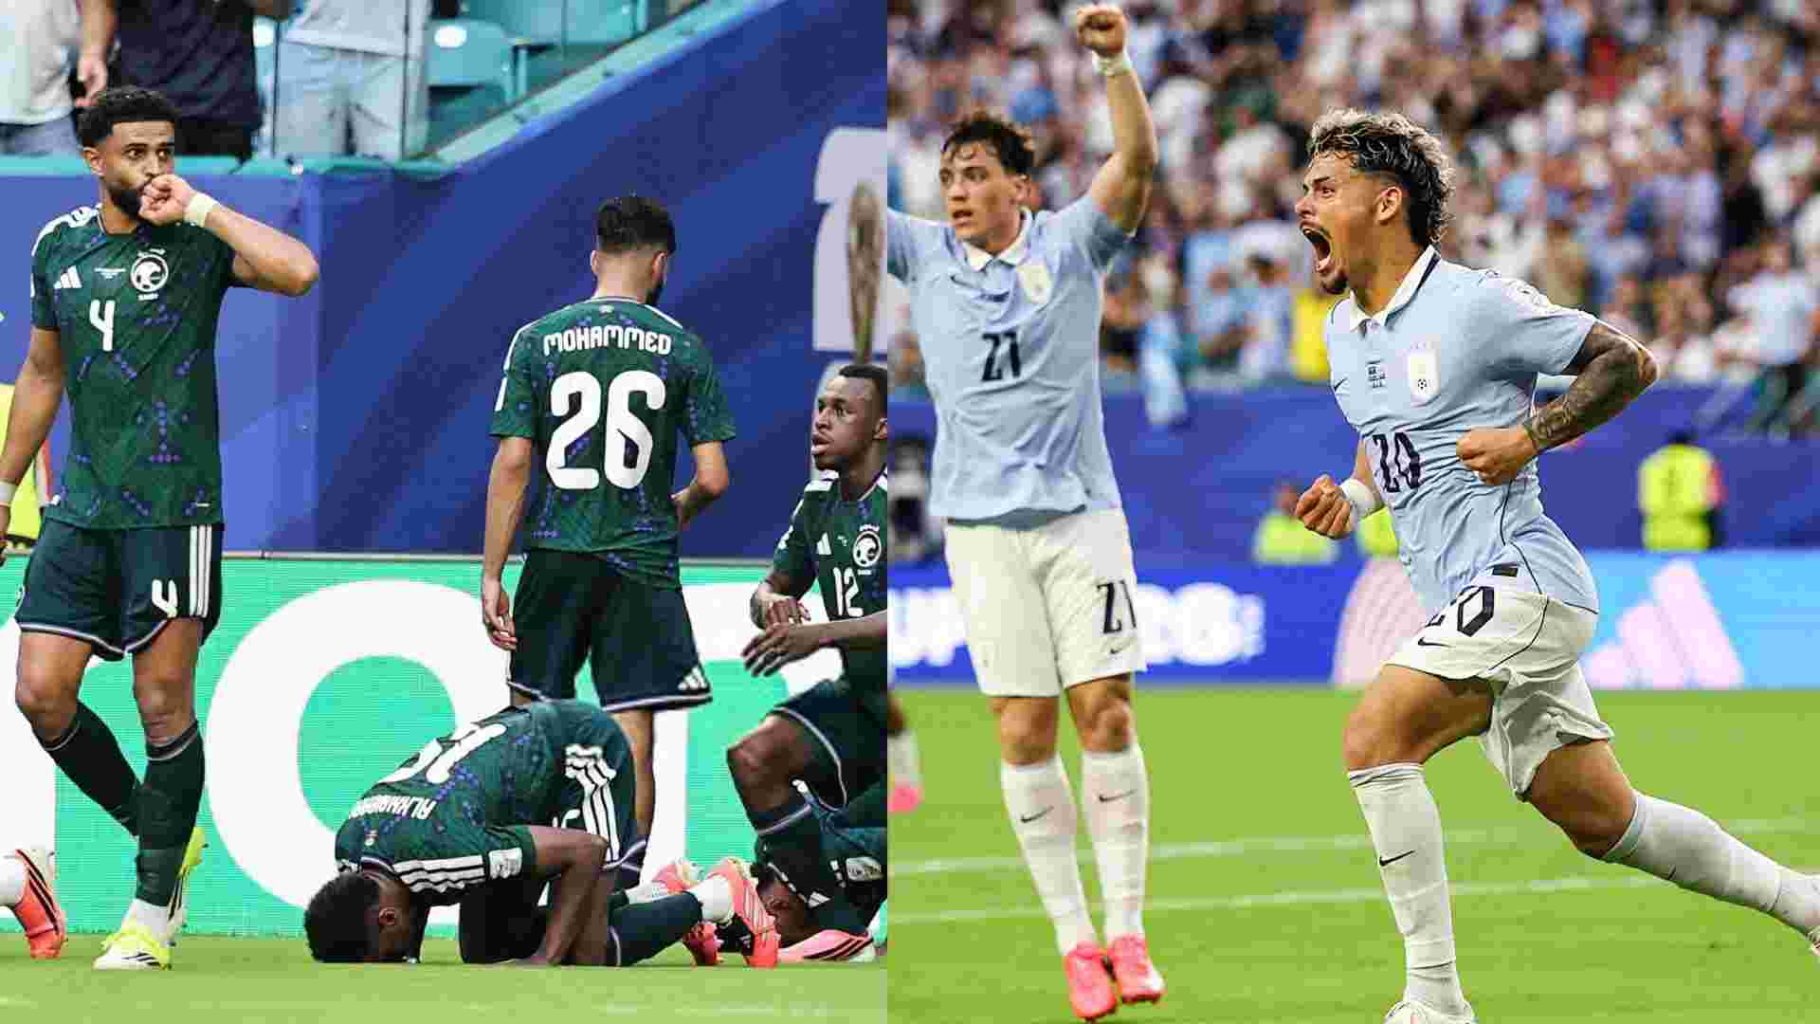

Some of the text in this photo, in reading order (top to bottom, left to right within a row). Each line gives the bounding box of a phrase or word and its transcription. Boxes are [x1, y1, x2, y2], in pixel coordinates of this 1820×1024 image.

[89, 299, 116, 352] 4
[543, 324, 672, 357] MOHAMMED
[981, 330, 1021, 381] 21
[545, 370, 667, 490] 26
[1372, 432, 1421, 493] 20
[151, 579, 178, 618] 4
[832, 567, 864, 617] 12
[1096, 579, 1137, 634] 21
